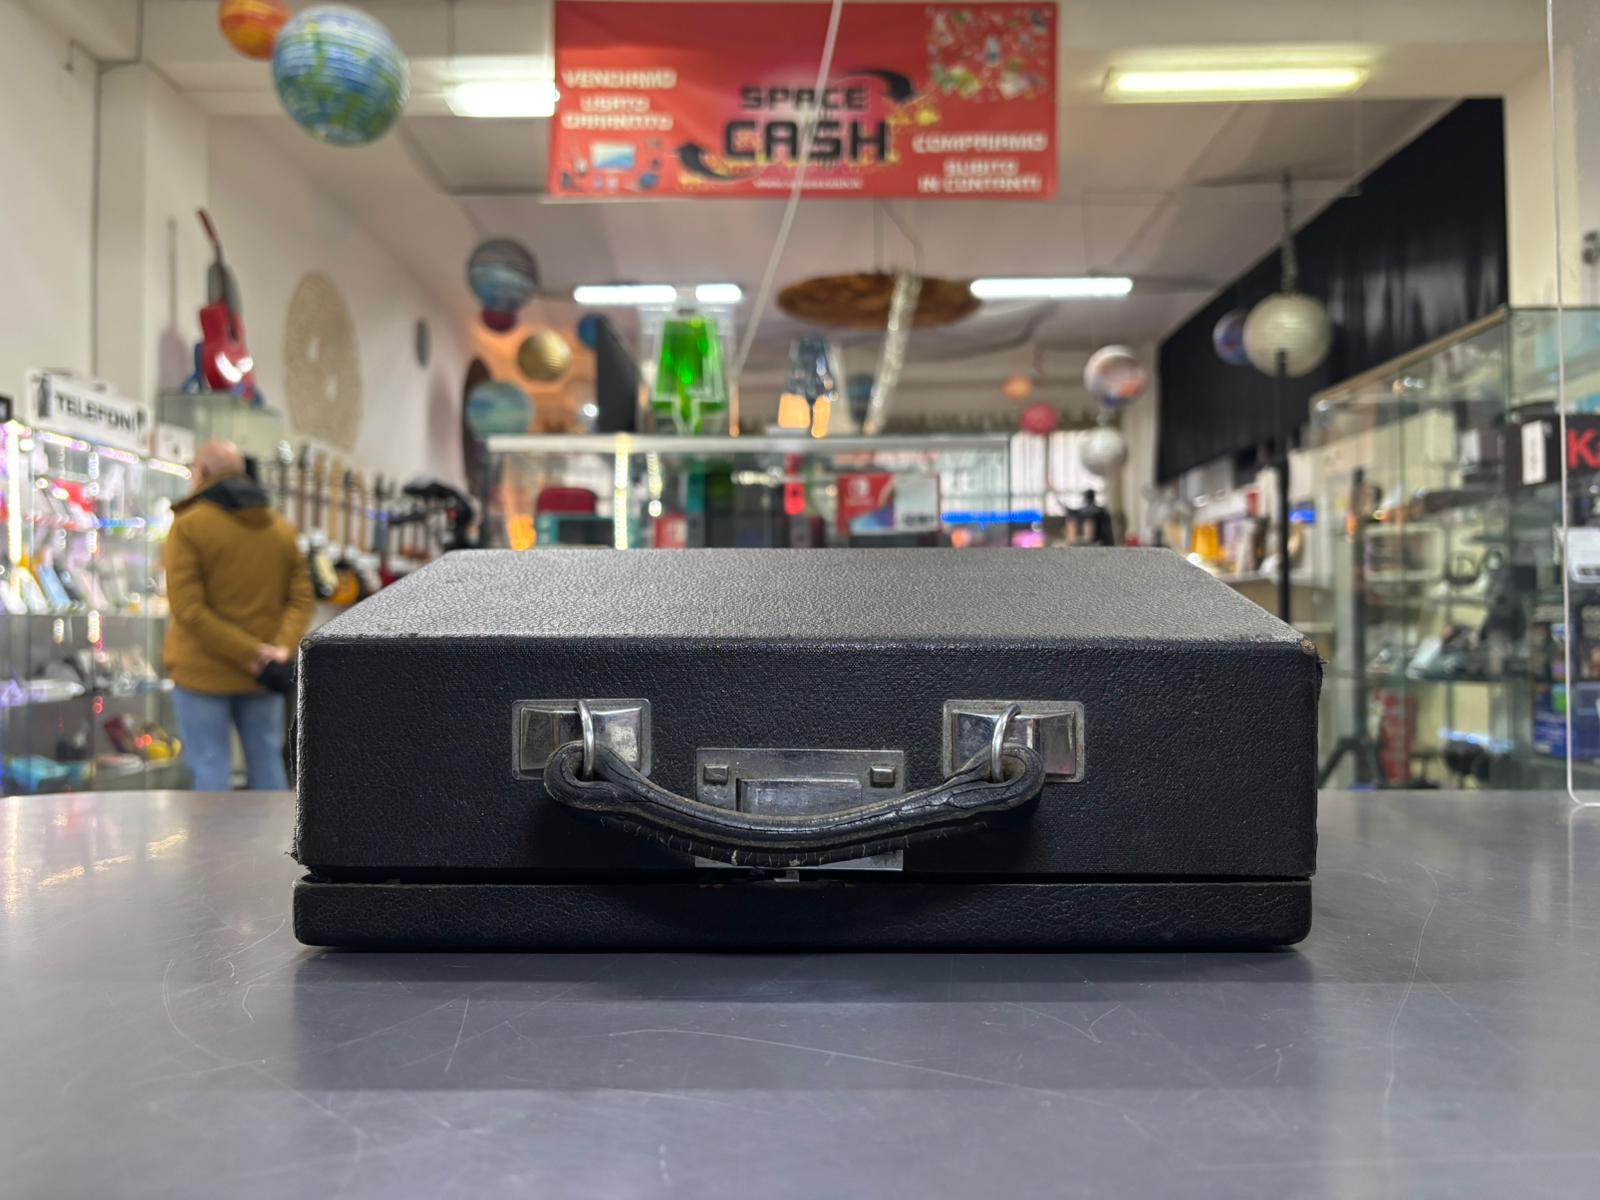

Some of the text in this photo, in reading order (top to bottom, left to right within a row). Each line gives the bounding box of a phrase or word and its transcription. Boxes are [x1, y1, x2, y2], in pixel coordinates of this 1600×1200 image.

[561, 69, 677, 89] VENDIAMO
[741, 86, 867, 110] SPACE
[724, 120, 888, 164] CASH
[55, 390, 138, 433] TELEFONI
[1567, 427, 1600, 470] K
